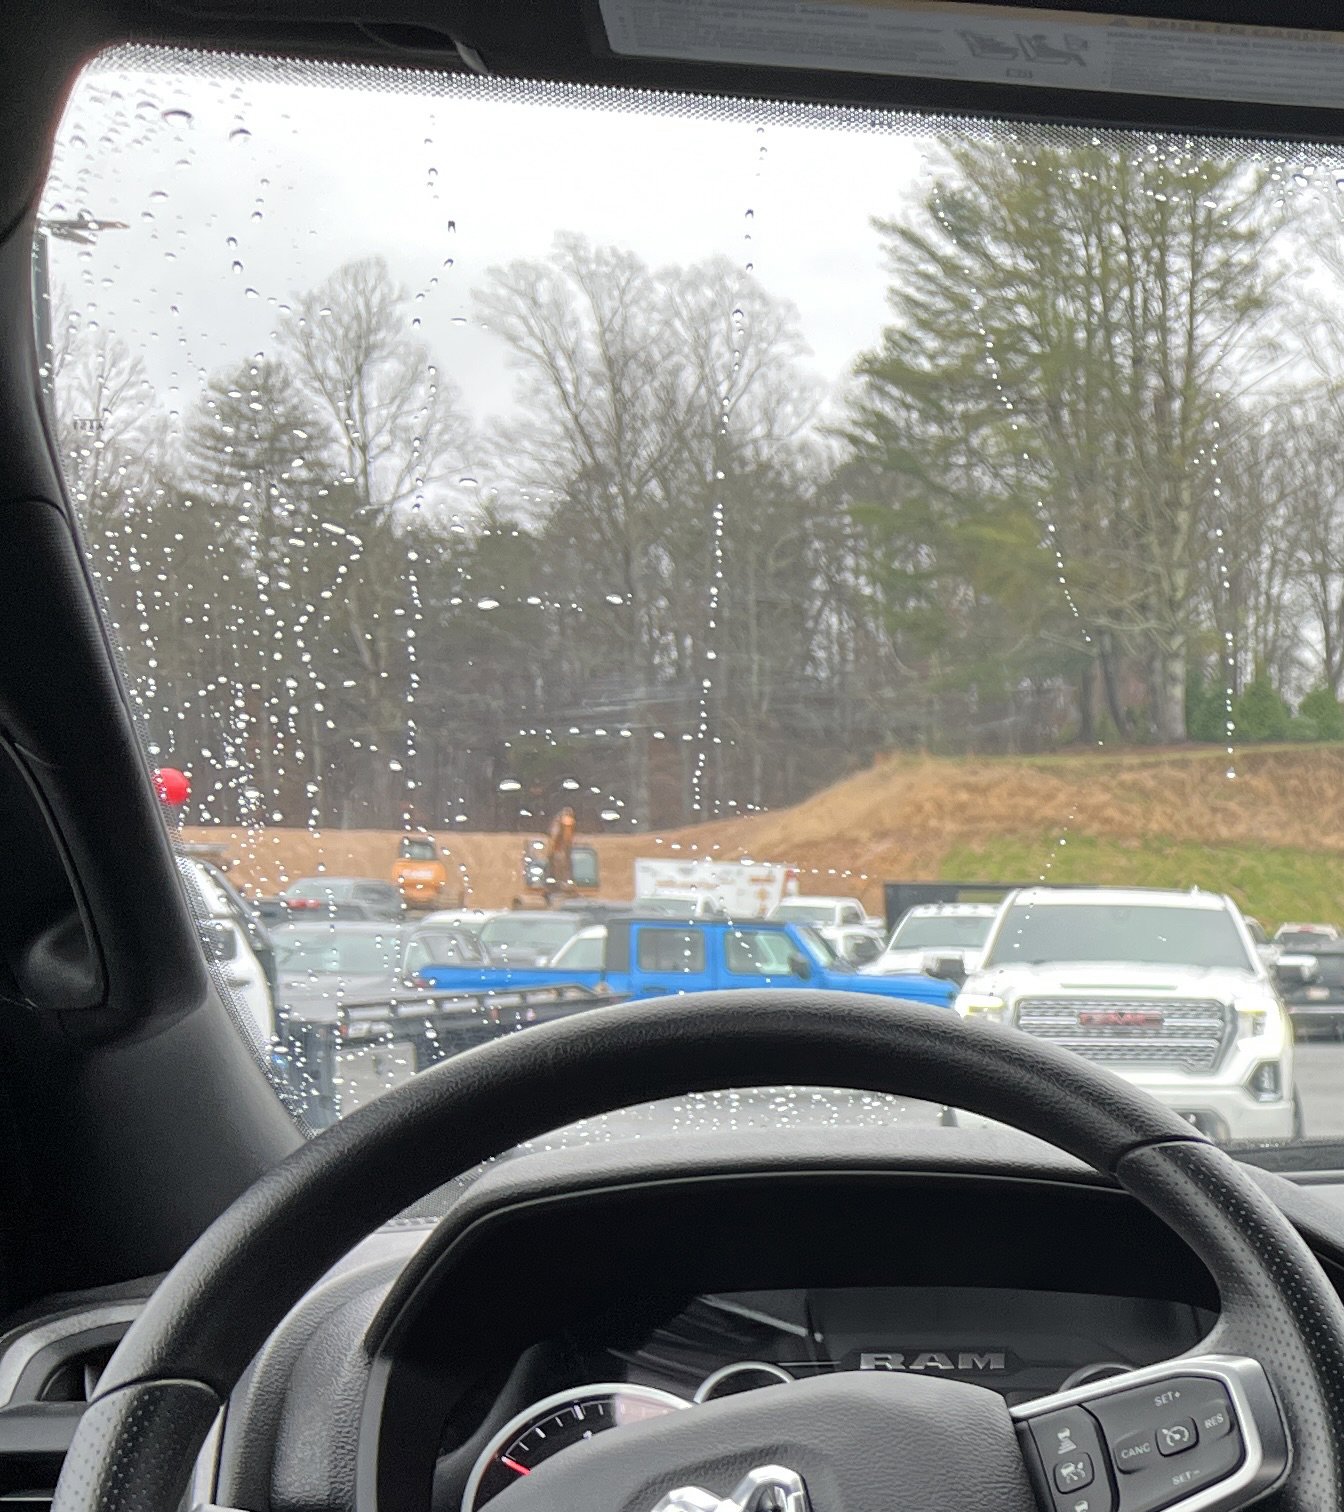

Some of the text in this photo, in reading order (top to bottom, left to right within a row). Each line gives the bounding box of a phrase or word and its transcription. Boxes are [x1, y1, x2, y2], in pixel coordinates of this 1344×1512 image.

[859, 1352, 1006, 1371] RAM
[1204, 1413, 1225, 1429] RES
[1121, 1442, 1151, 1459] CANC
